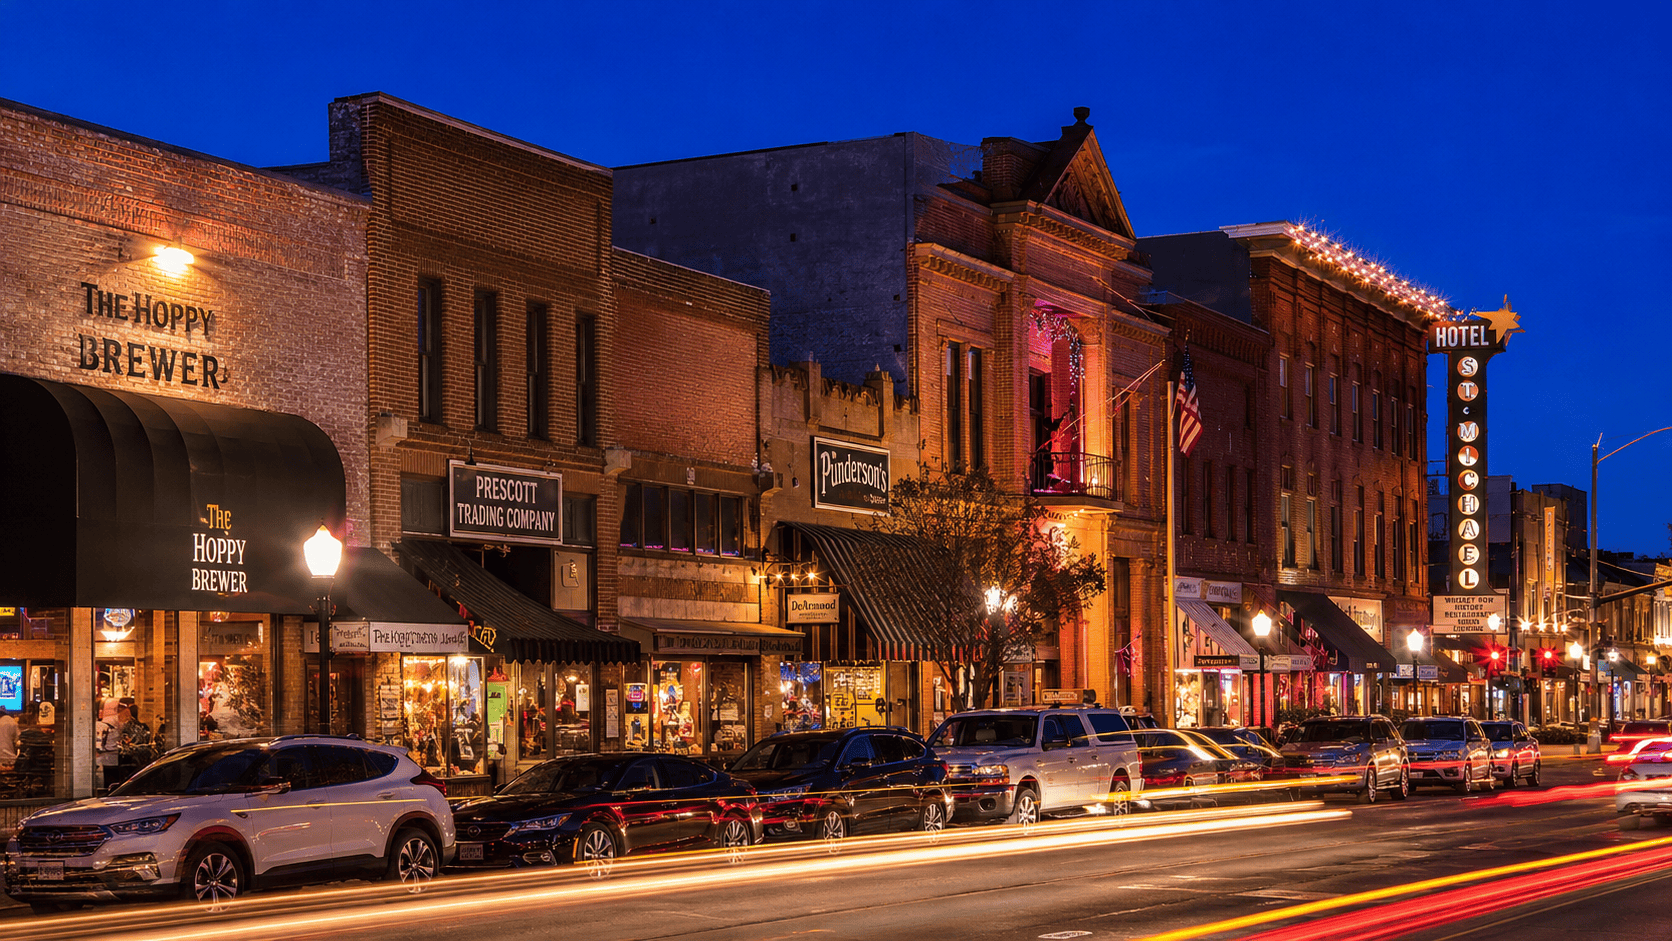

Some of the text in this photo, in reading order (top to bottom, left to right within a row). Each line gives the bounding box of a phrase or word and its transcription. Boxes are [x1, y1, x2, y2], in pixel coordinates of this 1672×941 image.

[134, 291, 213, 336] HOPPY
[1436, 325, 1489, 347] HOTEL
[78, 333, 221, 389] BREWER
[475, 475, 538, 504] PRESCOTT
[820, 450, 887, 497] Punderson's
[457, 503, 556, 532] TRADING COMPANY
[1458, 422, 1477, 587] MICHAEL
[192, 533, 247, 565] HOPPY
[191, 568, 248, 593] BREWER
